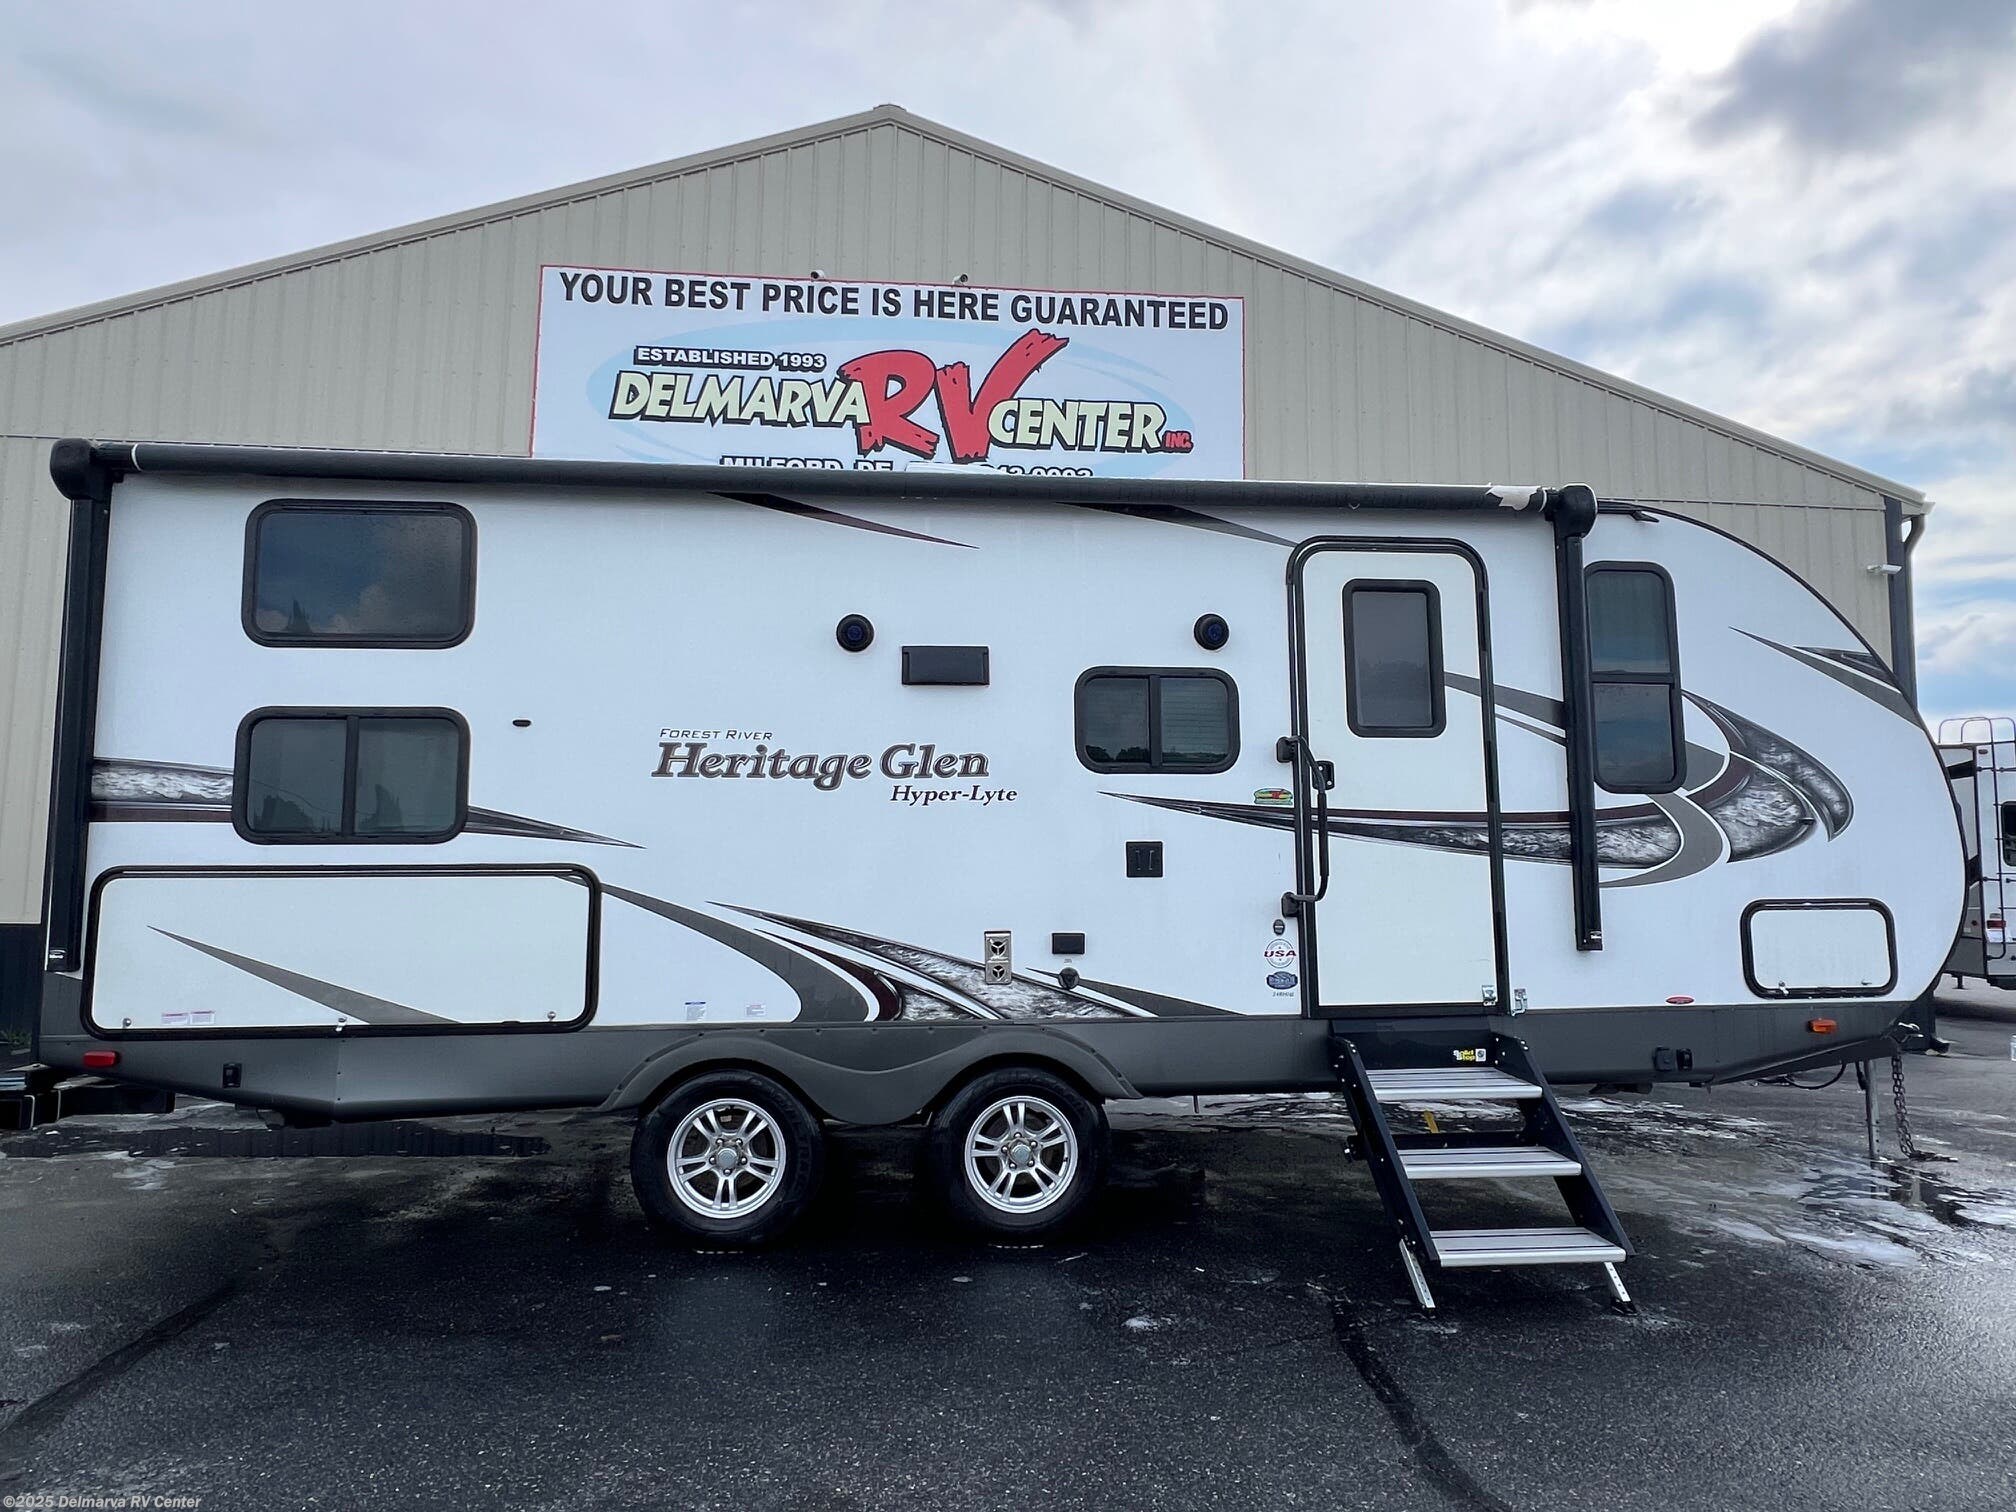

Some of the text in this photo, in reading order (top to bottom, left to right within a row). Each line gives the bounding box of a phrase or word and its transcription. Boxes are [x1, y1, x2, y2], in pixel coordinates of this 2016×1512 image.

[560, 271, 1229, 330] YOUR BEST PRICE IS HERE GUARANTEED
[635, 347, 826, 371] ESTABLISHED 1993
[609, 371, 871, 426] DELMARVA
[837, 329, 1069, 463] RV
[988, 398, 1166, 453] CENTER
[660, 728, 773, 741] FOREST RIVER
[651, 742, 990, 791] Heritage Glen
[890, 785, 1018, 806] Hyper-Lyte
